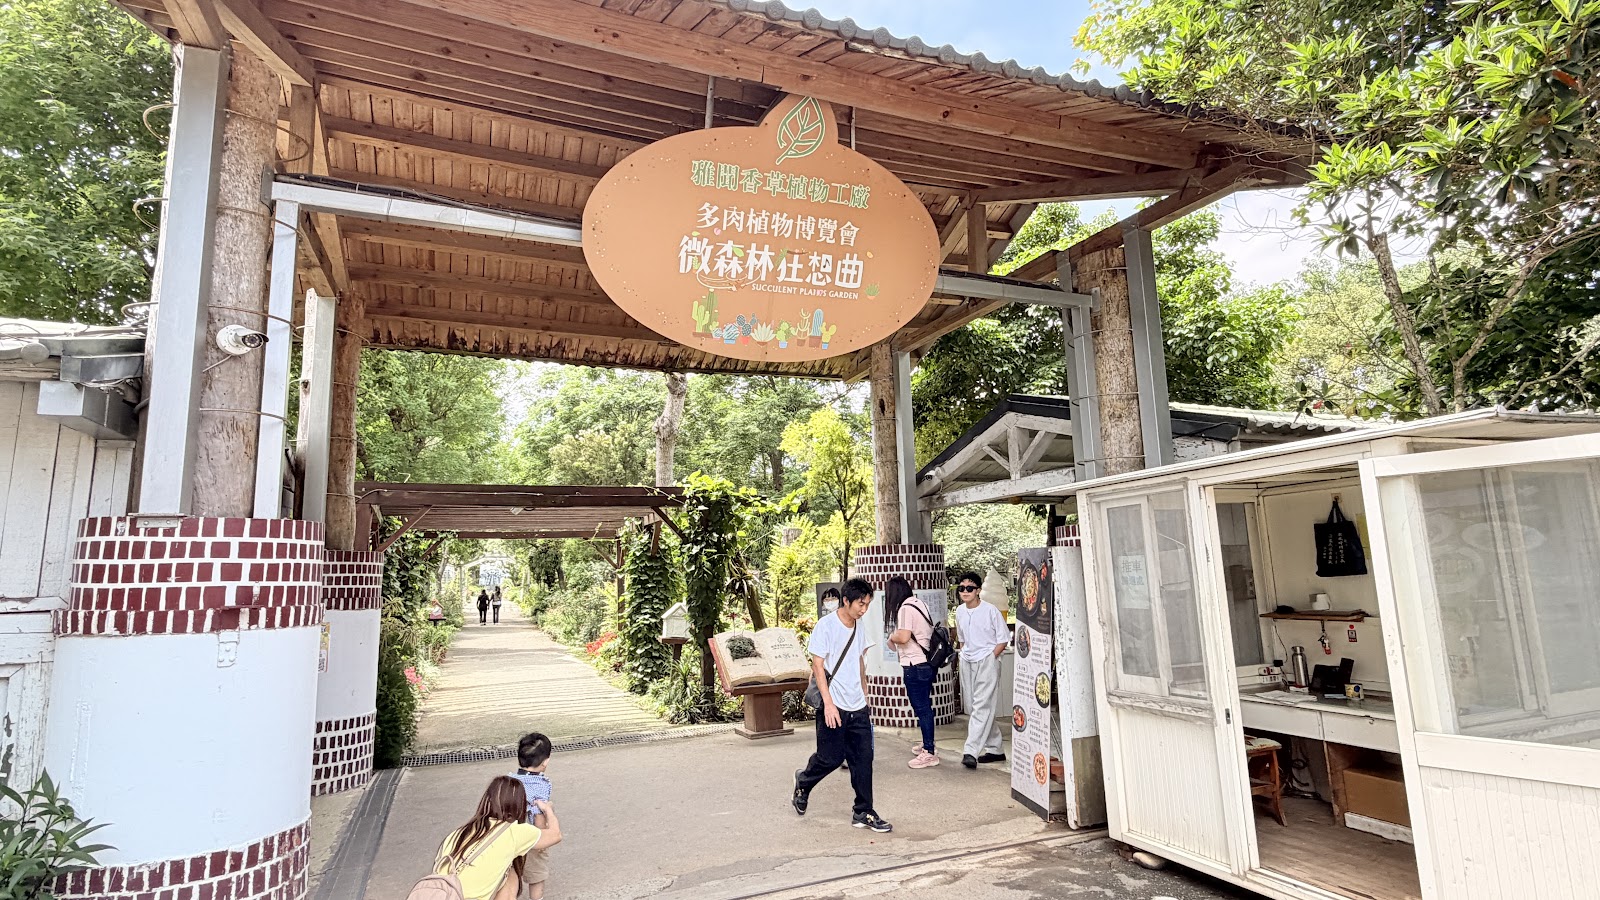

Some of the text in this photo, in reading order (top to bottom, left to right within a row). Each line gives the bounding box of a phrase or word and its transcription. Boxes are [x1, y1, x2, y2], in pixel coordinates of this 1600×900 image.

[691, 159, 869, 209] 雅聞香草植物工廠
[697, 202, 860, 247] 多肉植物博覽會
[678, 235, 864, 289] 微森林狂想曲
[751, 283, 797, 294] SUCCULENT
[828, 291, 858, 300] GARDEN
[1121, 559, 1142, 573] 推車
